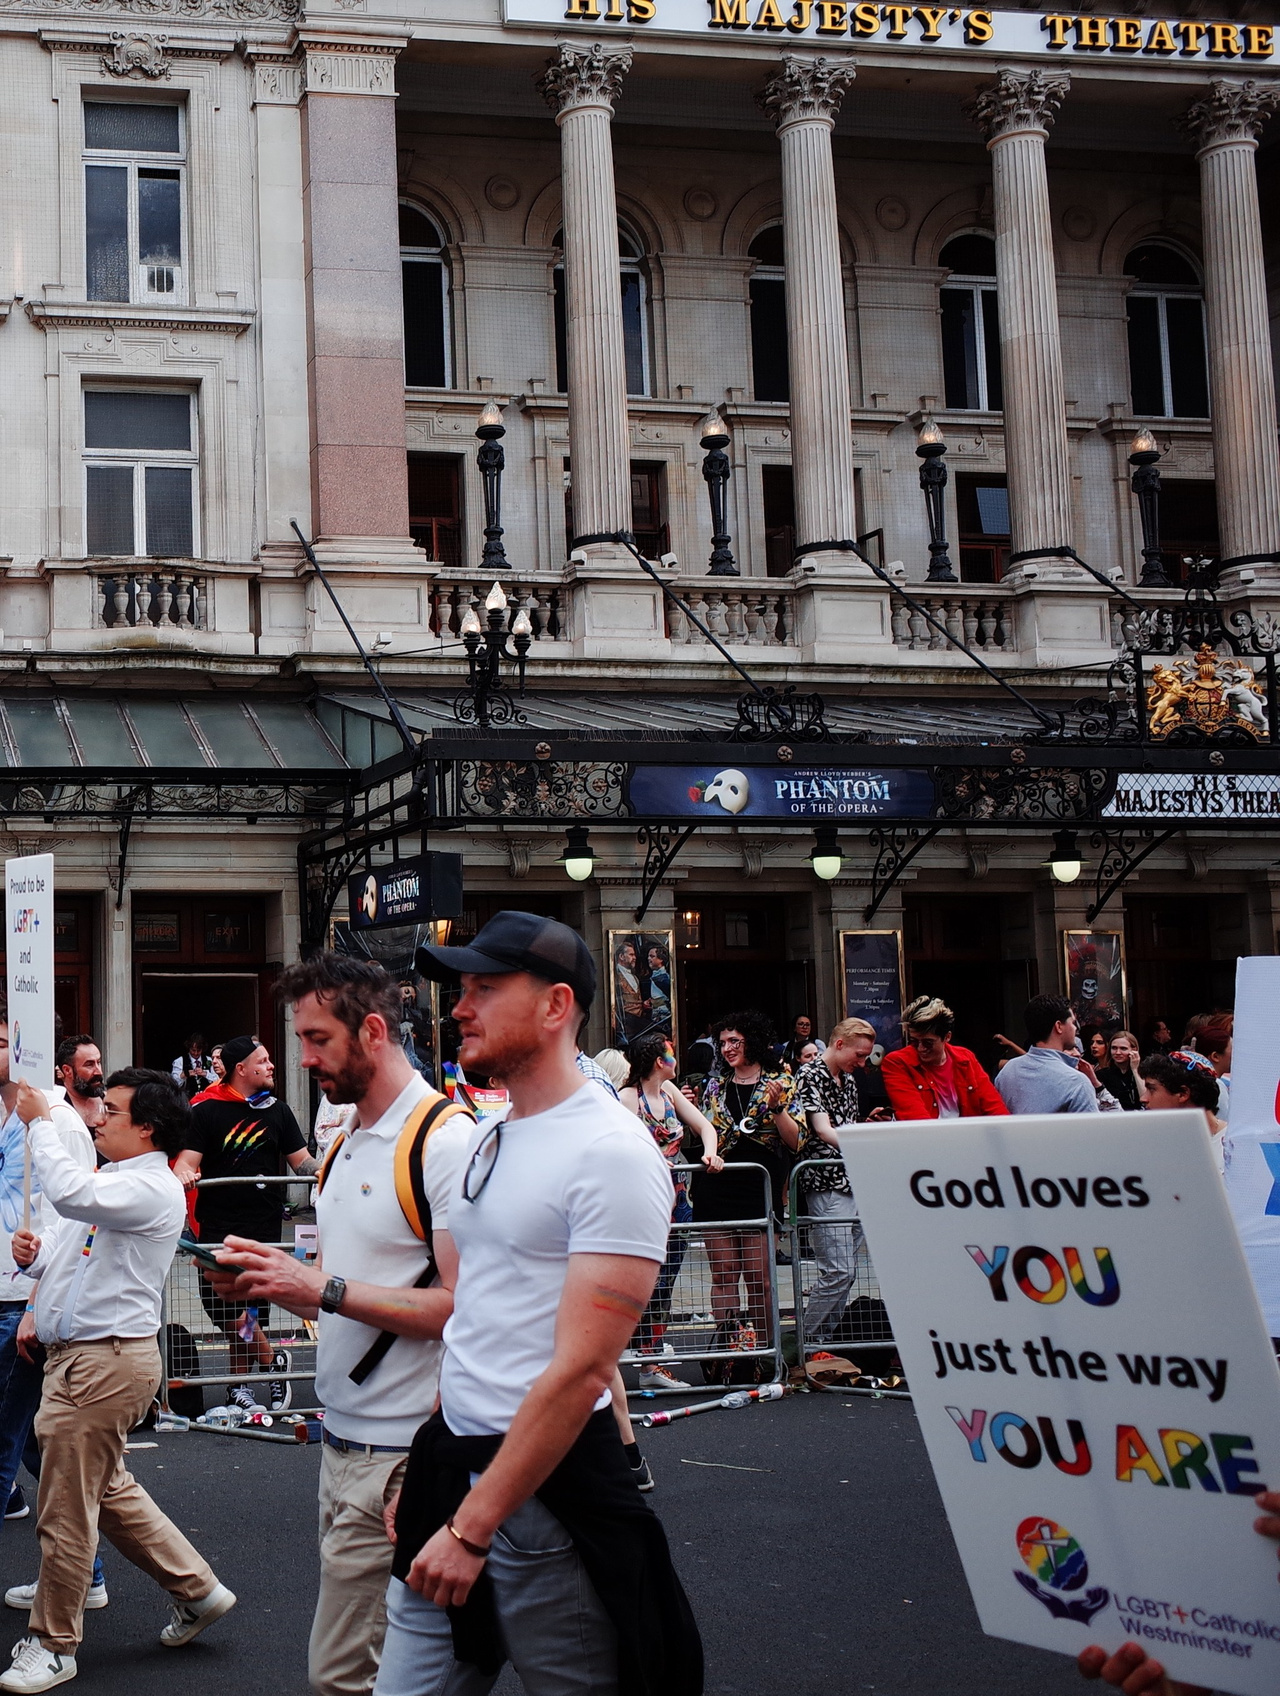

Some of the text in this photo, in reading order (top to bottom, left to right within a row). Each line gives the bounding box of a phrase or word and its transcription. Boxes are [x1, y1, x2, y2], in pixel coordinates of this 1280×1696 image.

[565, 0, 1275, 60] HIS MAJESTY'S THEATRE
[774, 776, 891, 800] PHANTOM
[1193, 776, 1236, 791] HIS
[791, 804, 878, 813] OF THE OPERA
[1115, 790, 1223, 813] MAJESTYS
[10, 875, 45, 895] Proud to be
[382, 876, 420, 903] PHANTOM
[387, 902, 416, 915] OF THE OPERA
[13, 909, 40, 933] LGBT+
[56, 926, 67, 935] IT
[215, 927, 240, 936] EXIT
[20, 946, 31, 964] and
[14, 975, 38, 994] Catholic
[910, 1165, 1150, 1210] God loves
[964, 1244, 1121, 1307] YOU
[928, 1329, 1229, 1403] just the way
[944, 1405, 1269, 1497] YOU ARE
[1119, 1616, 1253, 1658] Westminster
